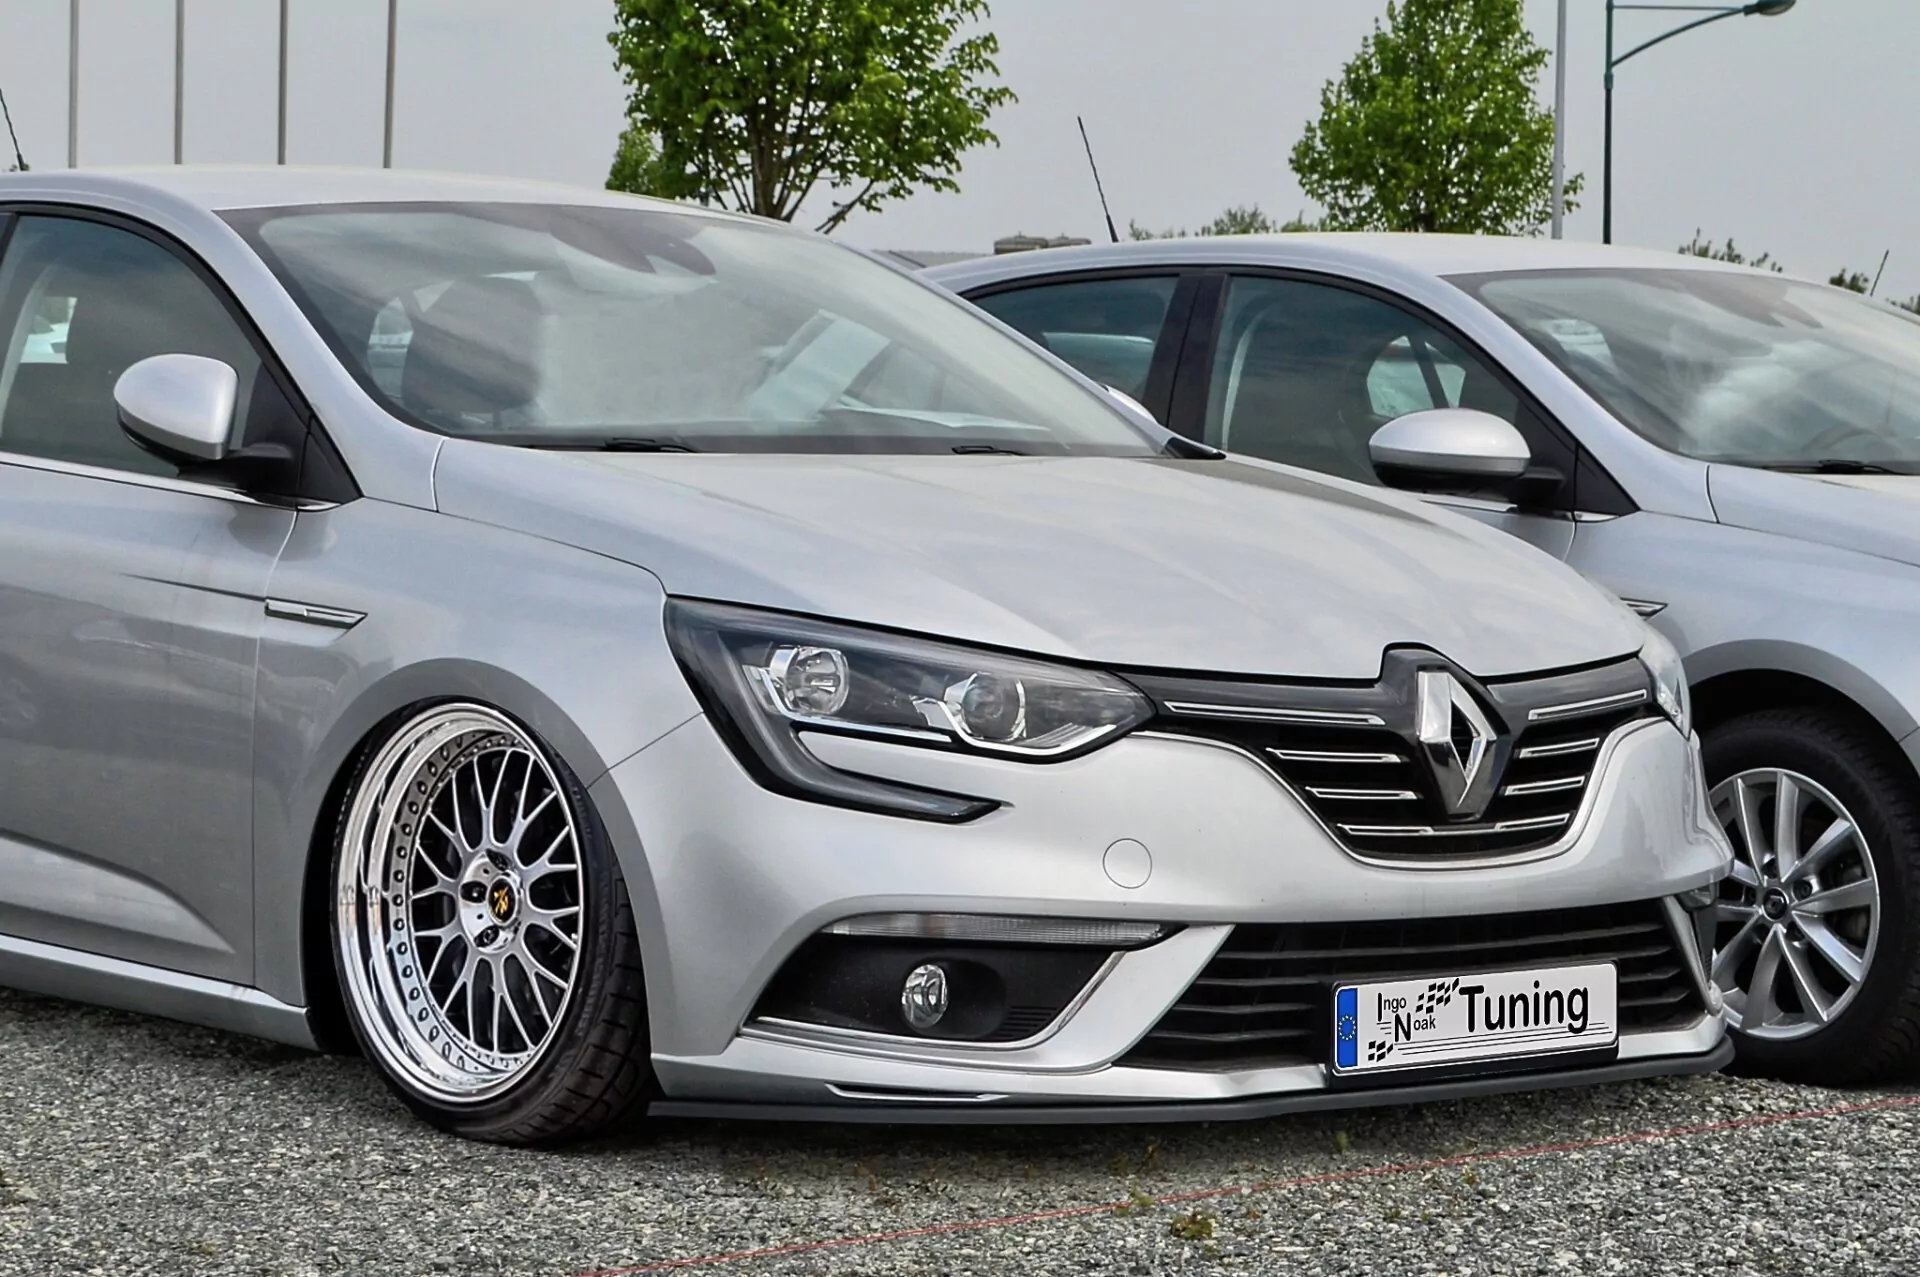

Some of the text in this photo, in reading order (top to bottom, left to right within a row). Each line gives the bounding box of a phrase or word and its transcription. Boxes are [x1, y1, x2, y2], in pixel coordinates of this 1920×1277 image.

[1377, 992, 1407, 1022] Ingo
[1458, 980, 1588, 1034] Tuning
[1394, 1013, 1436, 1042] Noak
